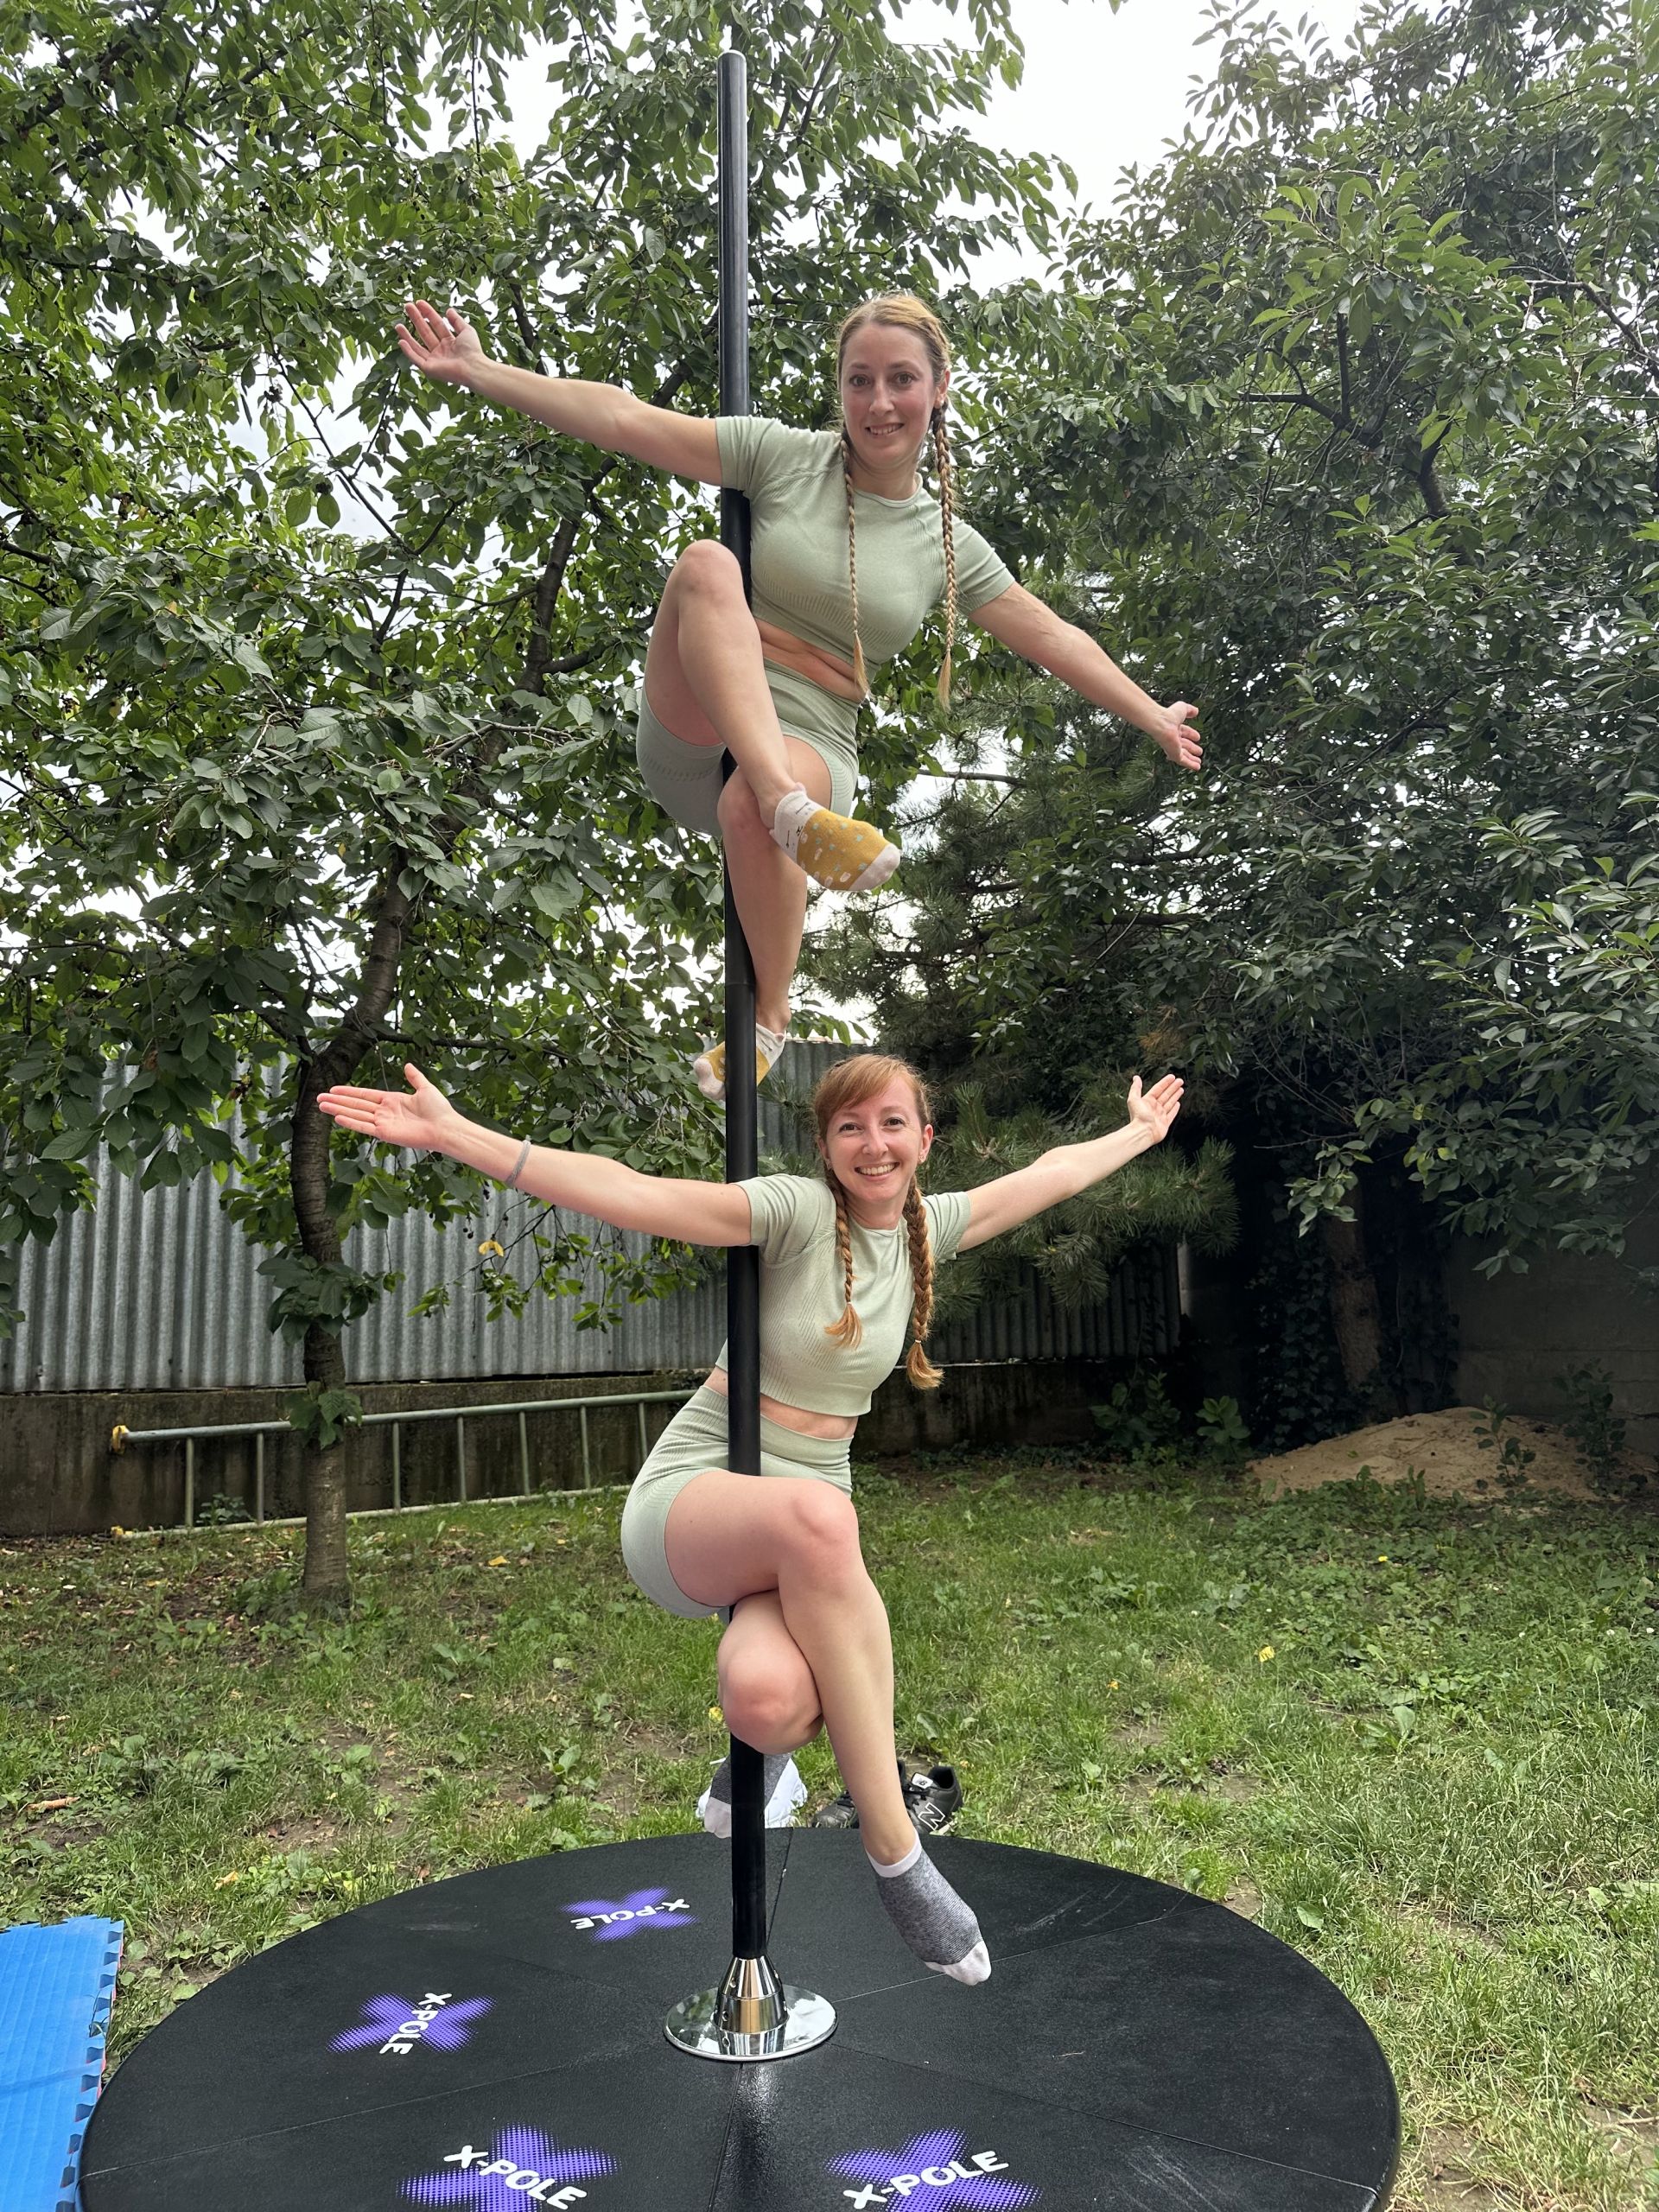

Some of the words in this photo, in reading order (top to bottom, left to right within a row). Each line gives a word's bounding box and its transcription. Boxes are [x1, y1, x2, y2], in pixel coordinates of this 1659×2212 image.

[918, 1802, 946, 1831] N
[570, 1898, 690, 1929] X-POLE
[378, 1993, 453, 2055] X-POLE
[443, 2145, 588, 2210] X-POLE
[842, 2150, 1009, 2209] X-POLE
